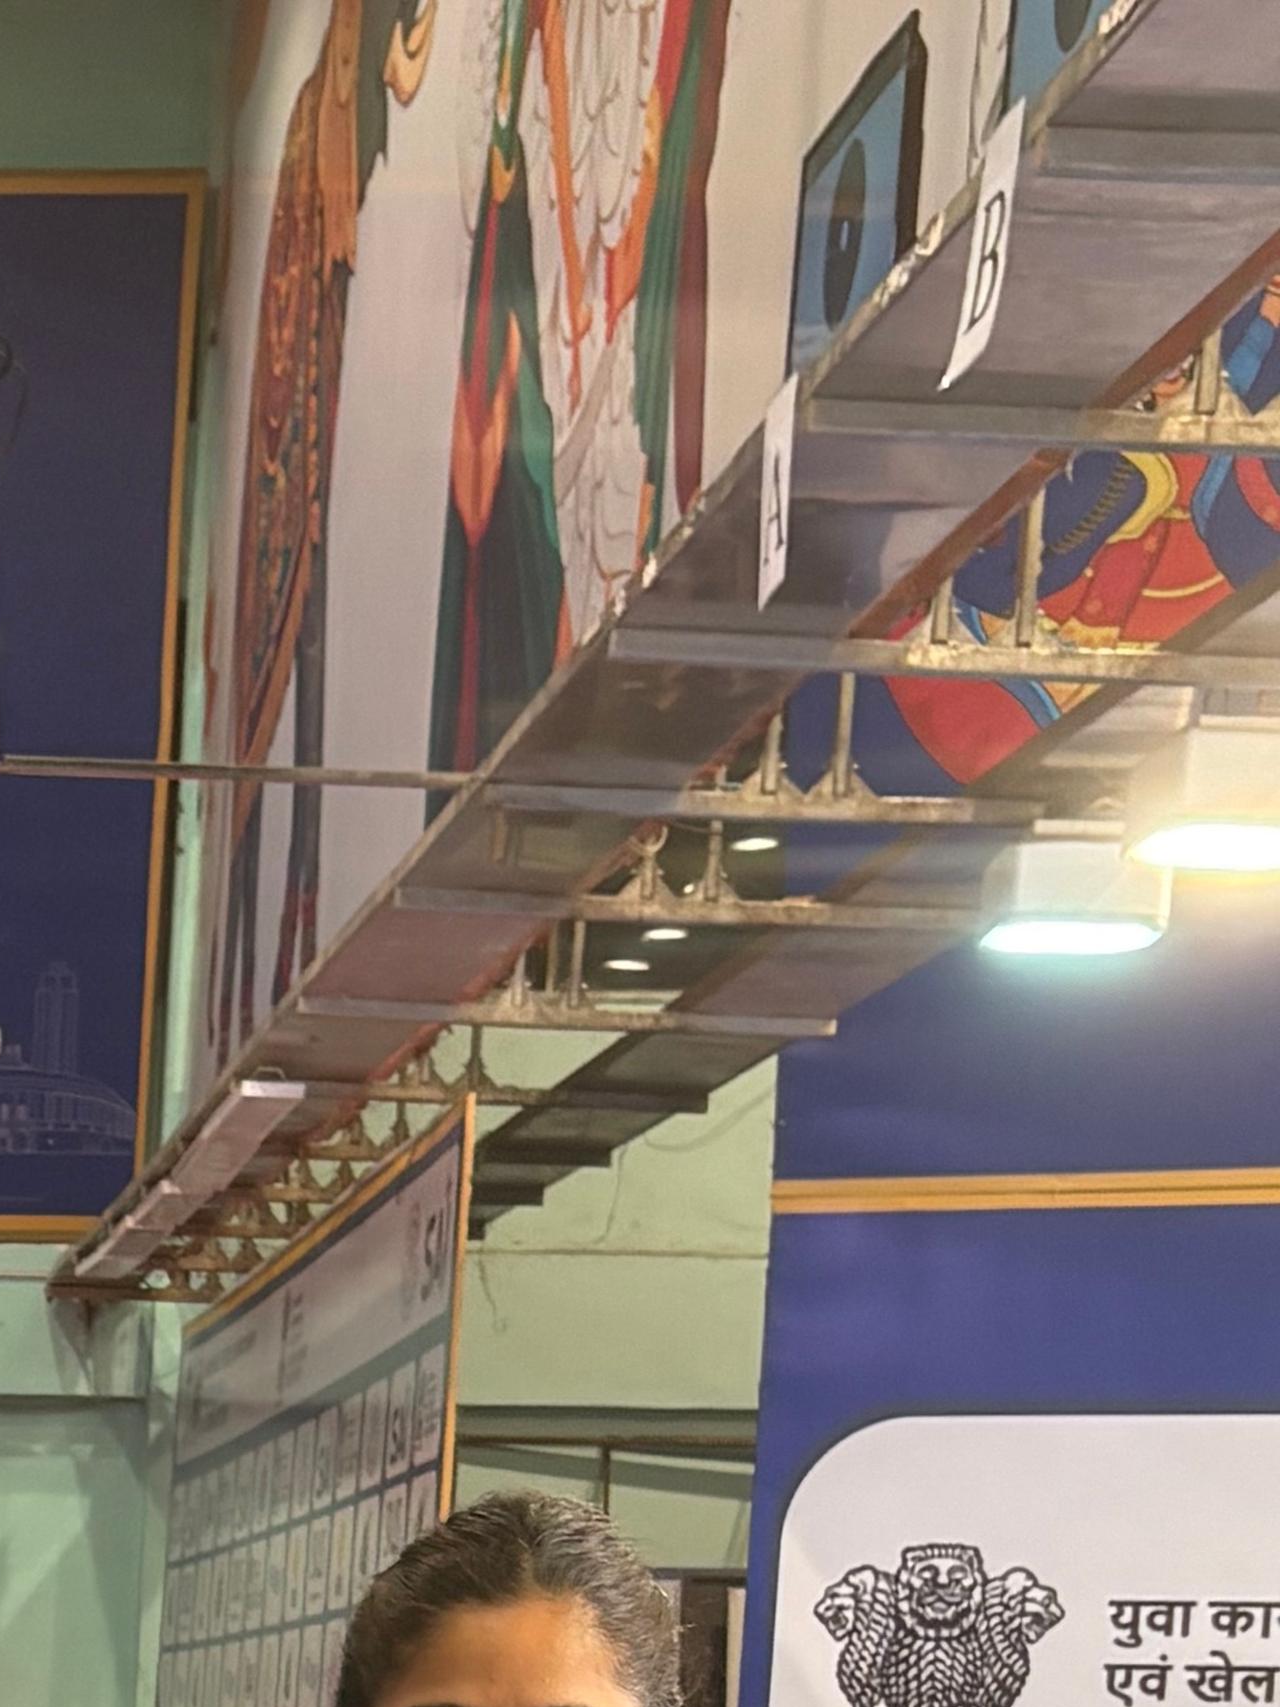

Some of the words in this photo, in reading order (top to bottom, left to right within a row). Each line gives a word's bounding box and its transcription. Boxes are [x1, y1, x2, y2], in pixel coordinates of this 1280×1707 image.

[1107, 1599, 1198, 1648] युवा
[1207, 1600, 1280, 1639] का
[1183, 1649, 1280, 1703] खेल
